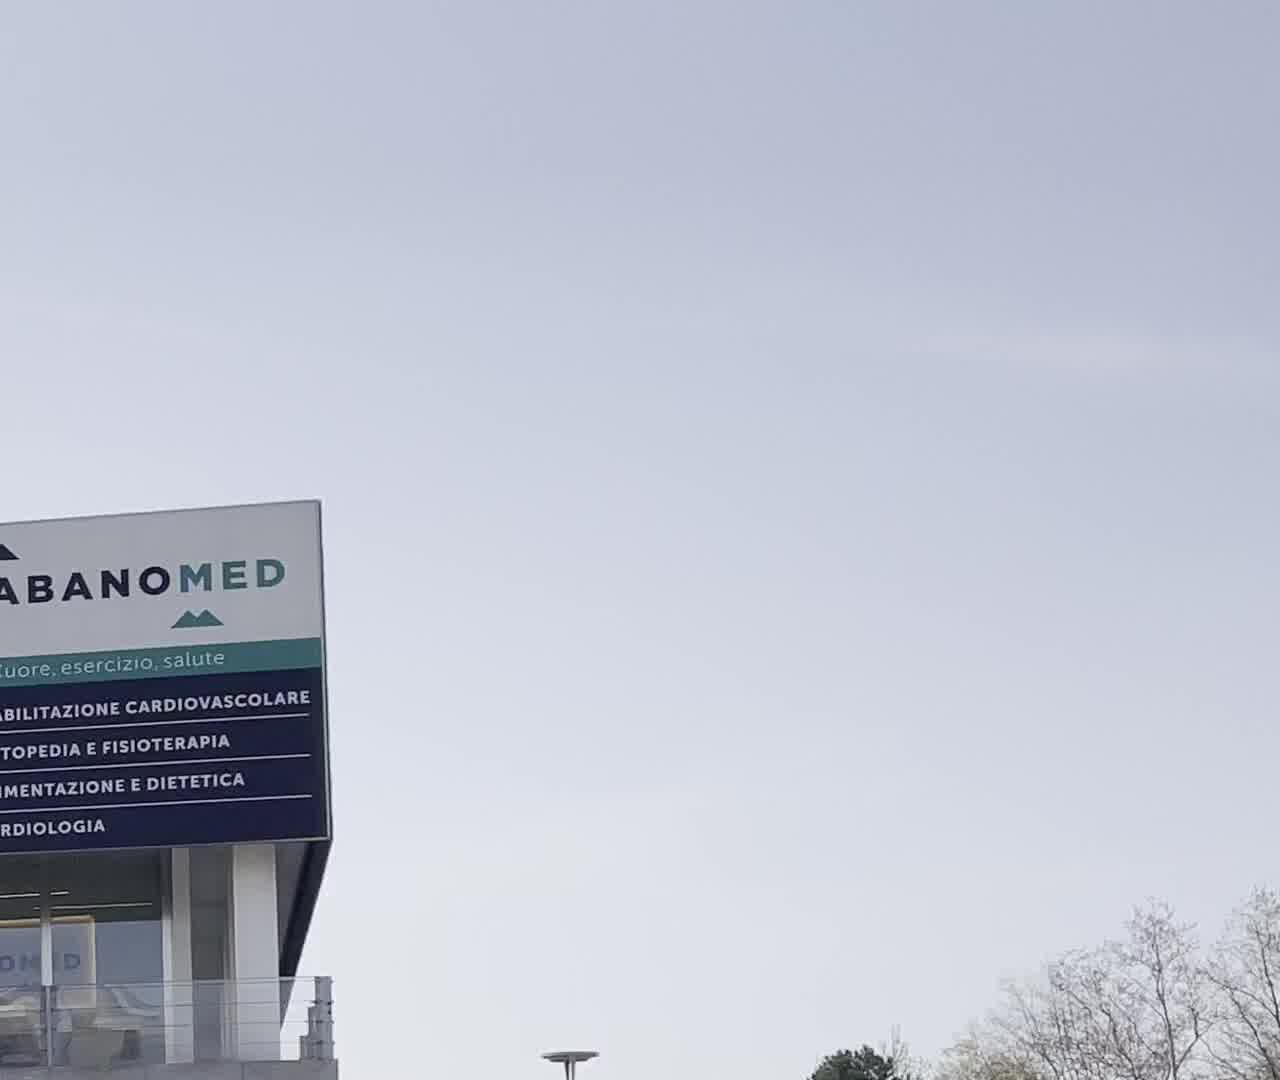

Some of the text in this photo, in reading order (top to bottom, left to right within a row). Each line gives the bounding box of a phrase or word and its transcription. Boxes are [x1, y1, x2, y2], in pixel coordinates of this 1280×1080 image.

[60, 656, 158, 675] esercizio,
[163, 651, 225, 669] salute
[125, 690, 311, 714] CARDIOVASCOLARE
[86, 742, 97, 755] E
[102, 734, 230, 754] FISIOTERAPIA
[130, 778, 141, 792] E
[147, 772, 245, 791] DIETETICA
